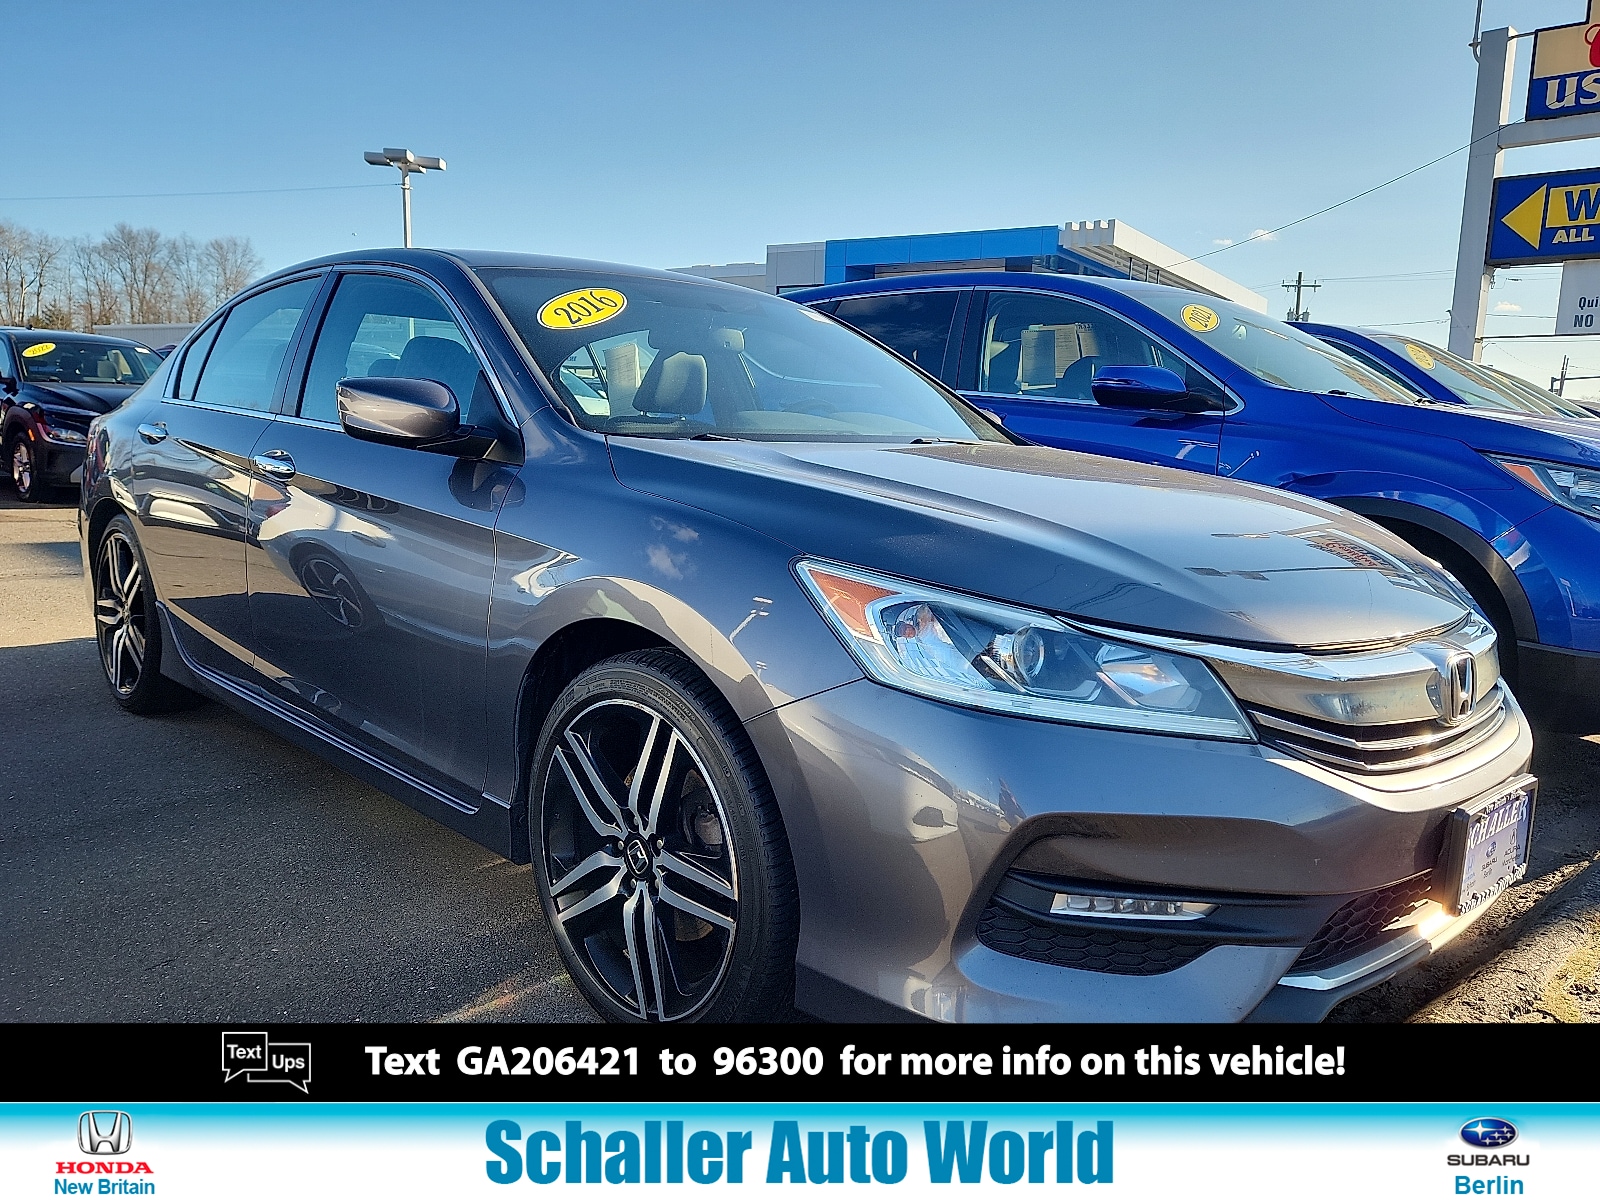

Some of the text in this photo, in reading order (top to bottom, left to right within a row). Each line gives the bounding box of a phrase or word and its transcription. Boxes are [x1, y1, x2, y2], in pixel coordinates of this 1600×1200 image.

[1552, 227, 1595, 244] ALL
[554, 291, 618, 324] 2016
[1573, 314, 1594, 328] NO
